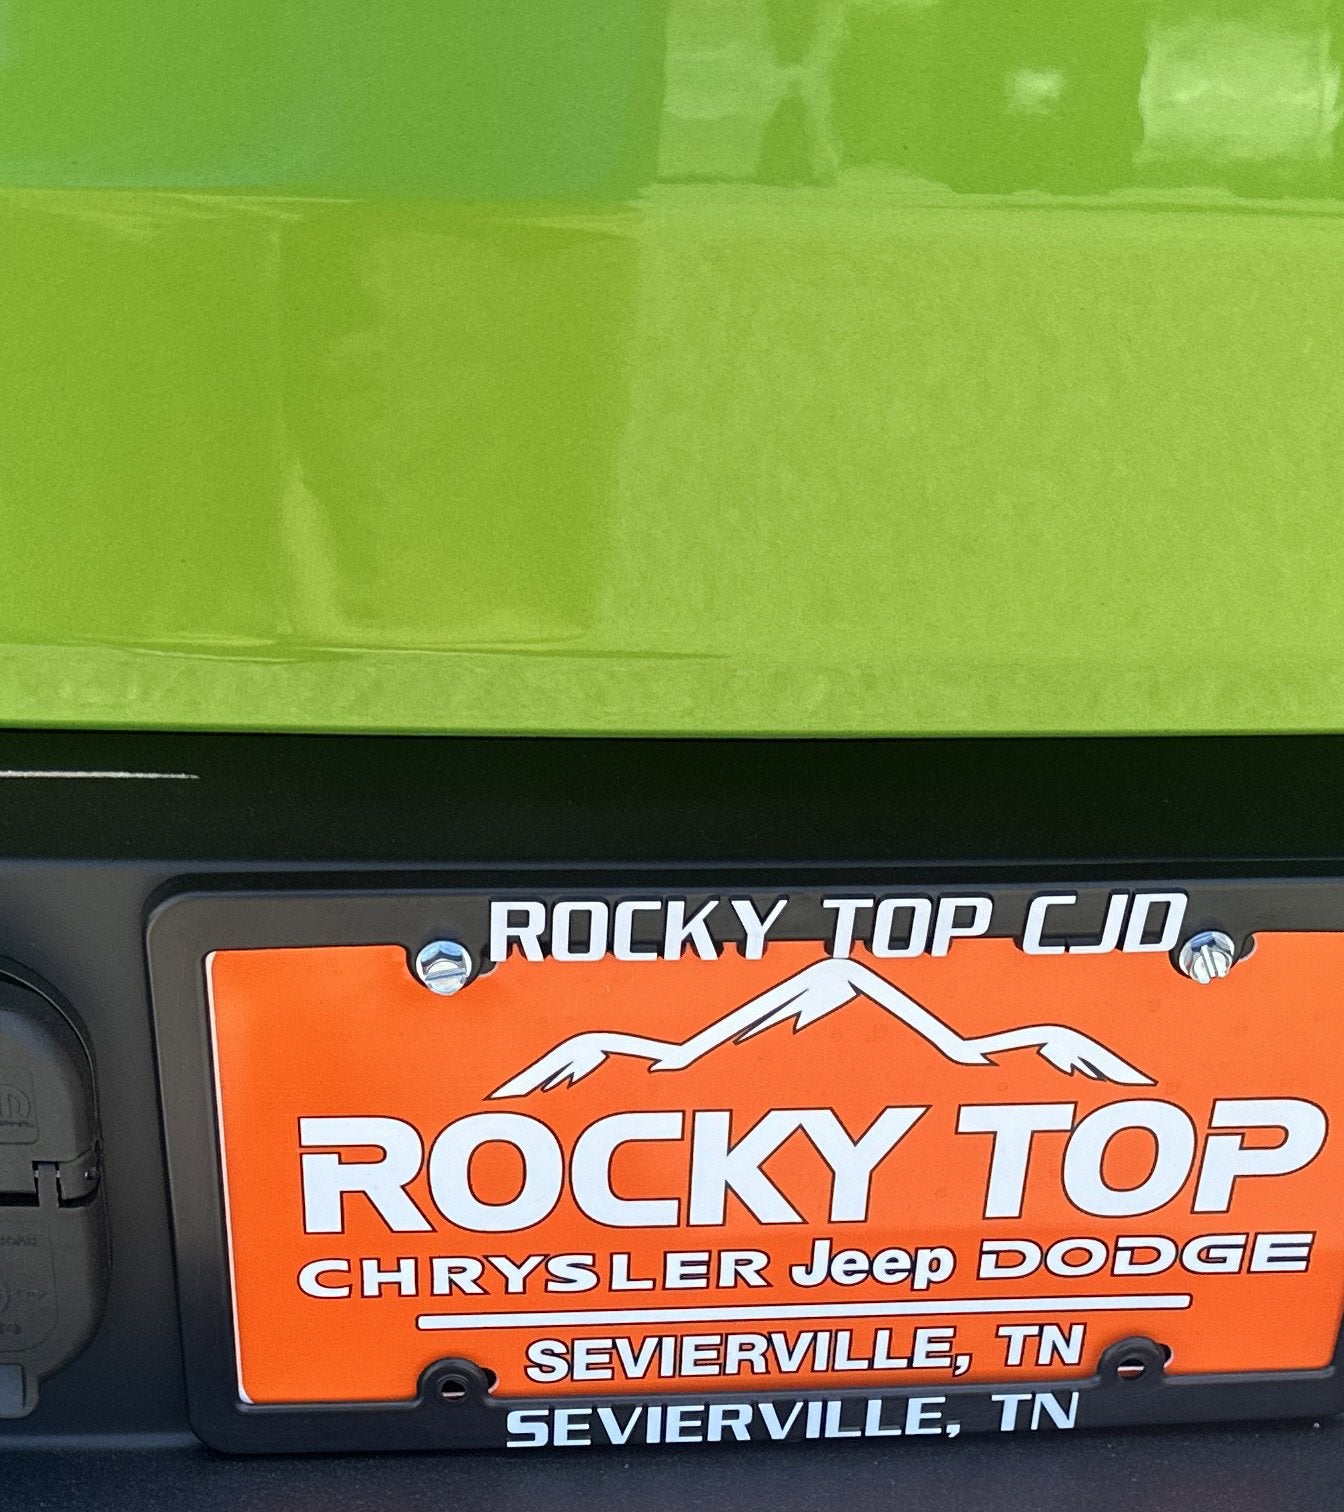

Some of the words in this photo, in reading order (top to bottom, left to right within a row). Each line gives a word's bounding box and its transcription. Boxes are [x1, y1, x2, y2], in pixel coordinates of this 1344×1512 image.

[488, 898, 789, 963] ROCKY
[821, 896, 994, 960] TOP
[1022, 892, 1189, 956] CJD
[297, 1106, 930, 1236] ROCKY
[956, 1098, 1329, 1218] TOP
[297, 1246, 770, 1300] CHRYSLER
[789, 1237, 958, 1292] Jeep
[978, 1232, 1316, 1281] DODGE
[524, 1326, 972, 1384] SEVIERVILLE,
[996, 1322, 1087, 1368] TN
[505, 1396, 962, 1449] SEVIERVILLE,
[991, 1389, 1081, 1433] TN
